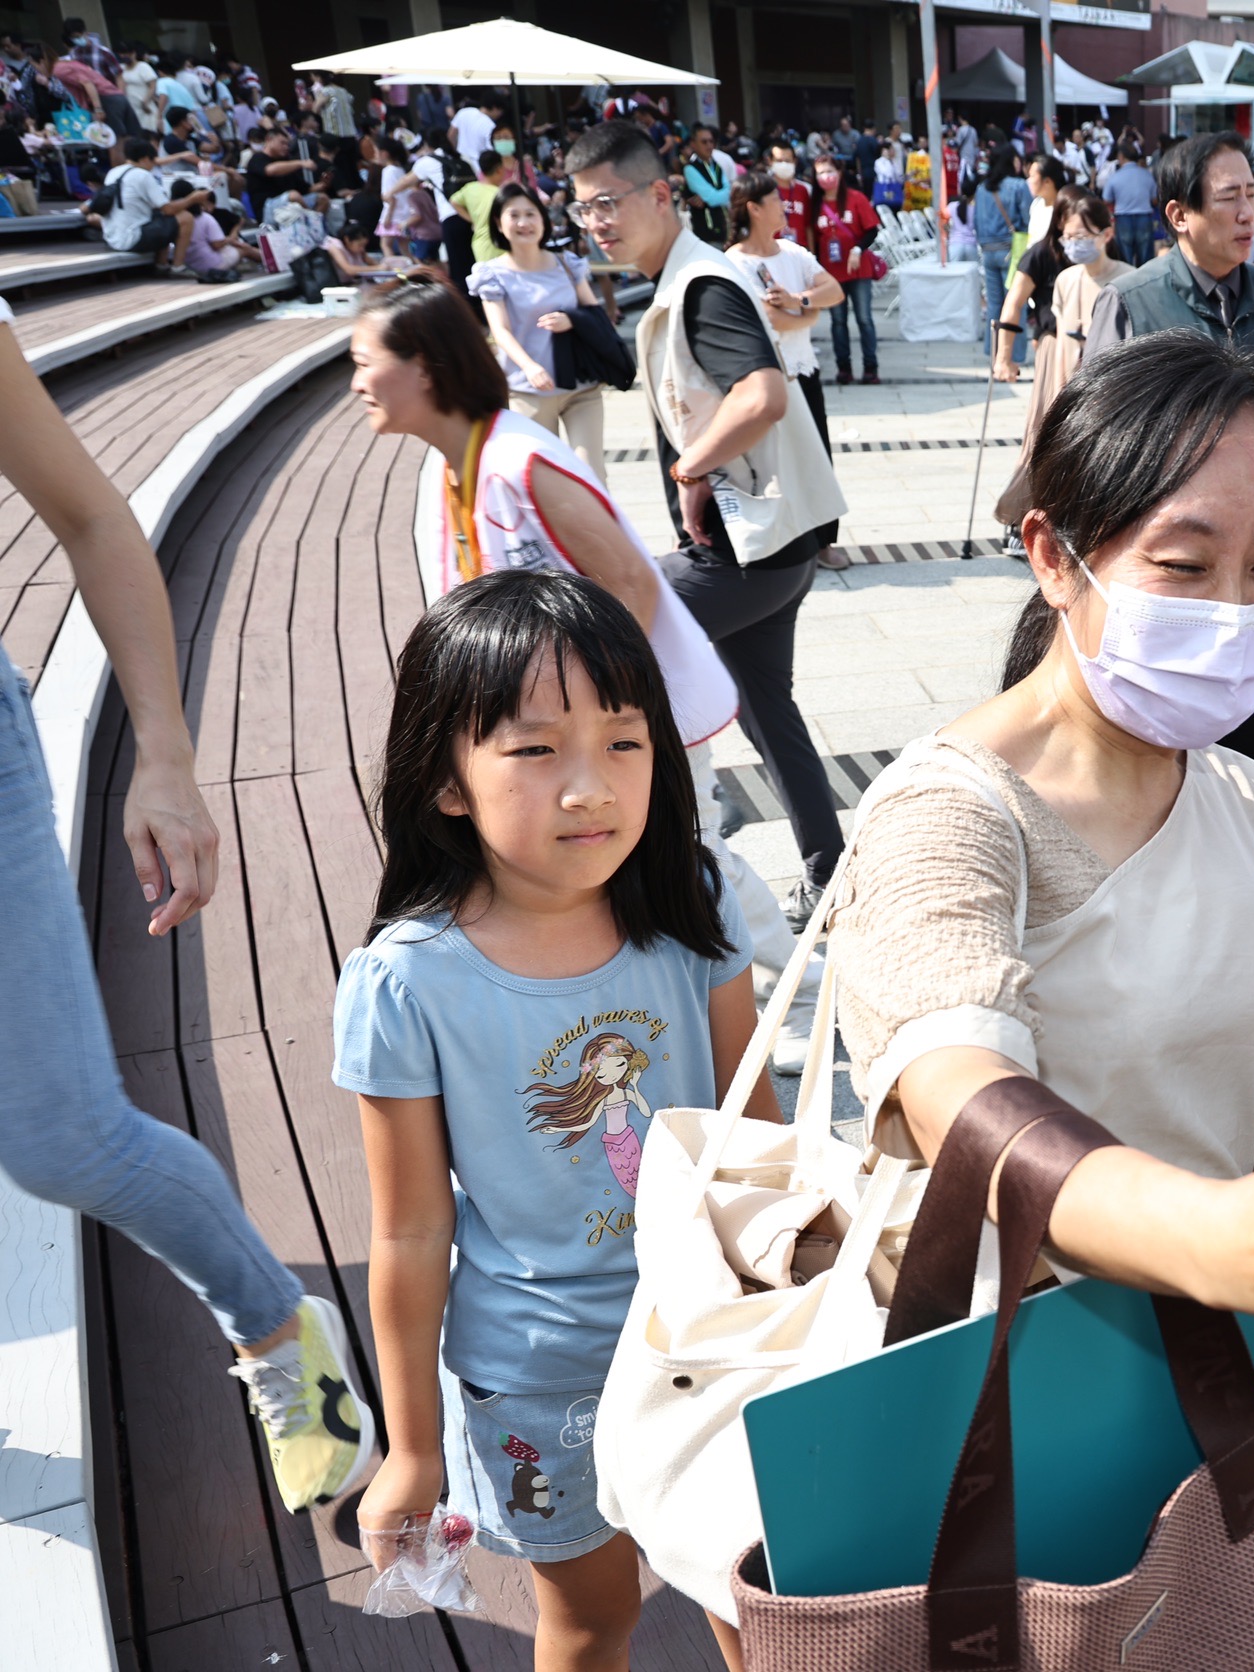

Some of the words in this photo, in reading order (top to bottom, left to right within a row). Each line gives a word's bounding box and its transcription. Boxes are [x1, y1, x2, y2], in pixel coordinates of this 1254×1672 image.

[592, 1008, 650, 1028] waves
[648, 1017, 669, 1041] of
[575, 1406, 597, 1427] smi
[579, 1428, 593, 1440] to
